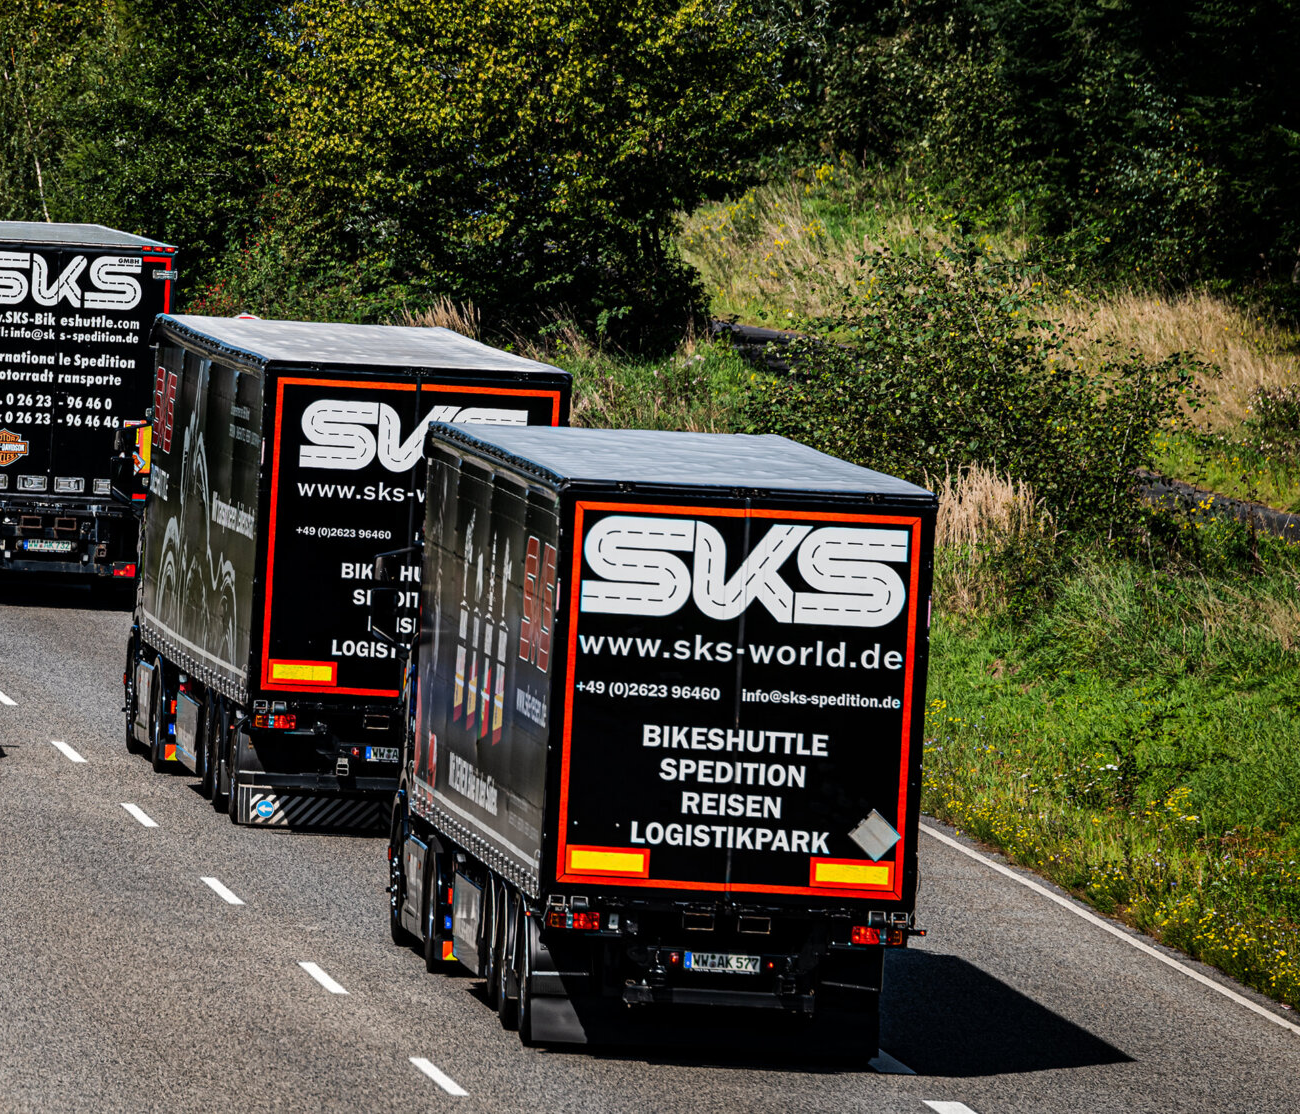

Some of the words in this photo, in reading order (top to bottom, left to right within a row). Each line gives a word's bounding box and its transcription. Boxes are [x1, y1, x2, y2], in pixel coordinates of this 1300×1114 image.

[74, 354, 135, 368] Spedition
[6, 393, 14, 405] 0
[17, 394, 32, 406] 26
[36, 395, 51, 407] 23
[67, 396, 82, 408] 96
[86, 398, 101, 409] 46
[105, 398, 112, 410] 0
[5, 411, 13, 423] 0
[16, 412, 32, 423] 26
[35, 413, 50, 424] 23
[66, 414, 81, 426] 96
[85, 415, 100, 427] 46
[104, 416, 119, 428] 46
[296, 527, 315, 535] +49
[318, 528, 355, 538] (0)2623
[359, 530, 391, 539] 96460
[581, 515, 908, 627] SKS
[577, 634, 904, 671] www.sks-world.de
[577, 681, 605, 693] +49
[609, 682, 667, 698] (0)2623
[672, 686, 720, 700] 96460
[742, 689, 900, 708] info@sks-spedition.de
[643, 725, 828, 759] BIKESHUTTLE
[659, 758, 805, 787] SPEDITION
[681, 792, 781, 818] REISEN
[629, 821, 829, 856] LOGISTIKPARK
[692, 954, 709, 967] WW
